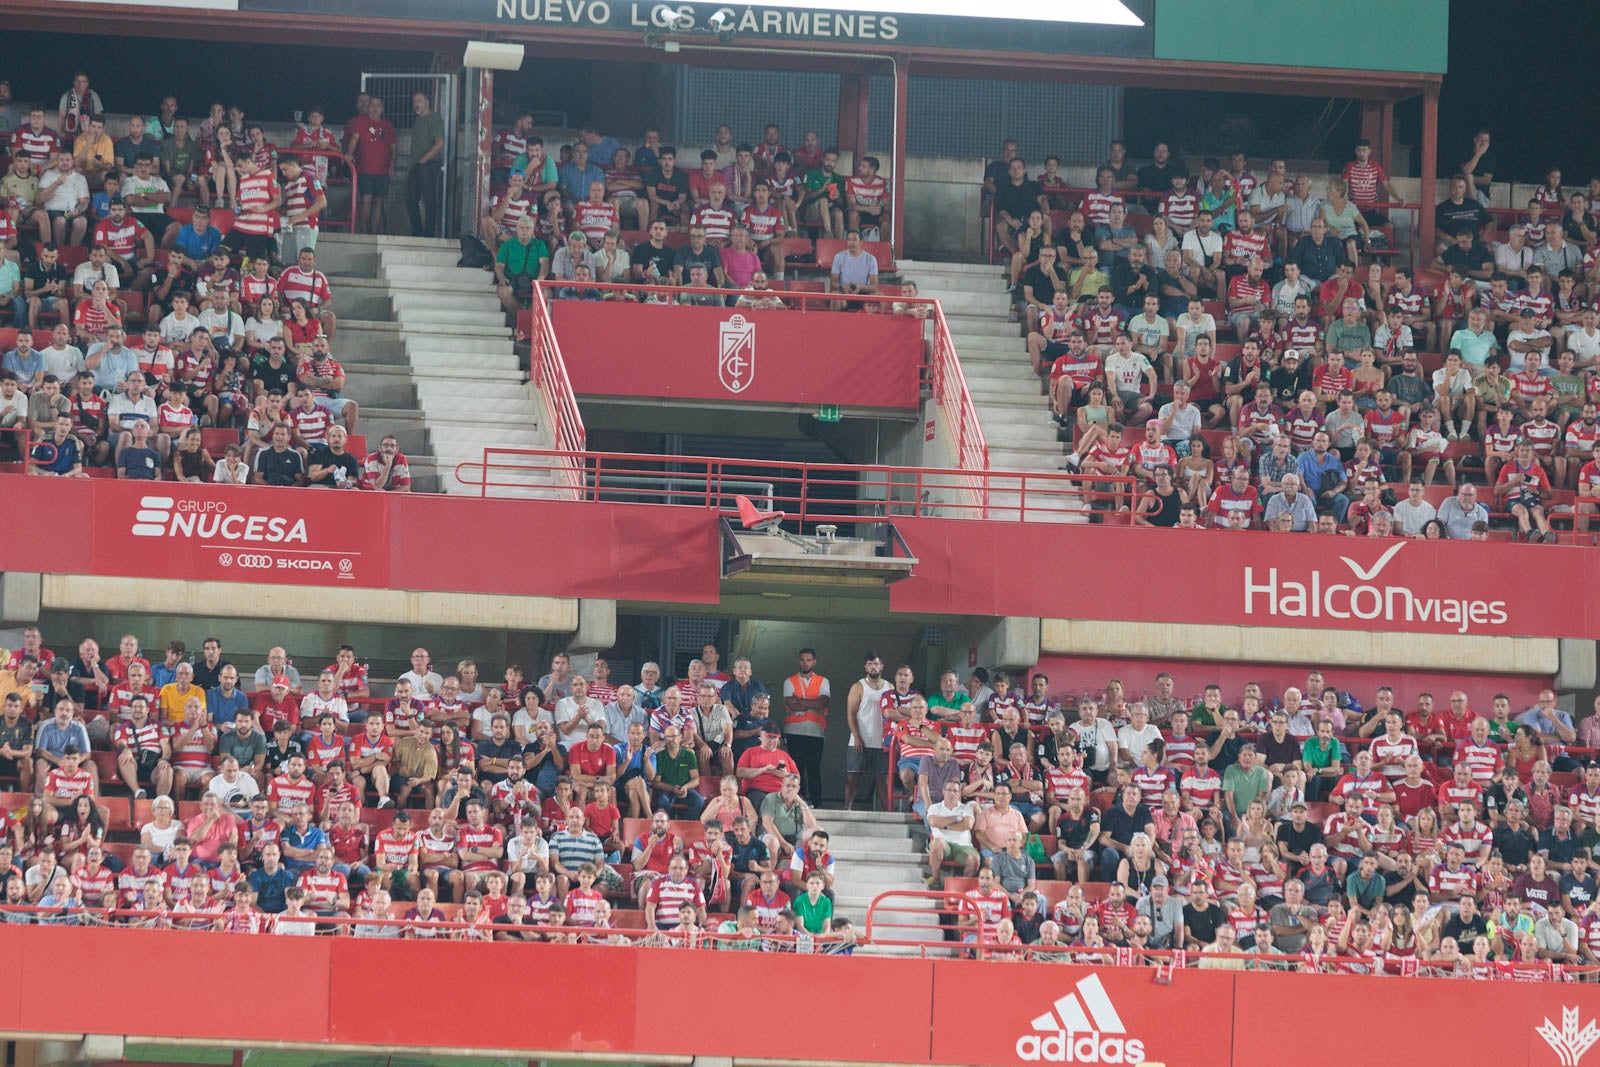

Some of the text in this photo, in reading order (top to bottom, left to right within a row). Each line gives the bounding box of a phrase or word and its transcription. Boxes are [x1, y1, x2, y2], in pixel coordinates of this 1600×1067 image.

[496, 0, 610, 25] NUEVO
[631, 3, 695, 28] LOS
[177, 500, 227, 514] GRUPO
[169, 512, 308, 543] NUCESA
[276, 559, 333, 570] SKODA
[1525, 887, 1549, 900] VANS
[1016, 1029, 1145, 1064] adidas
